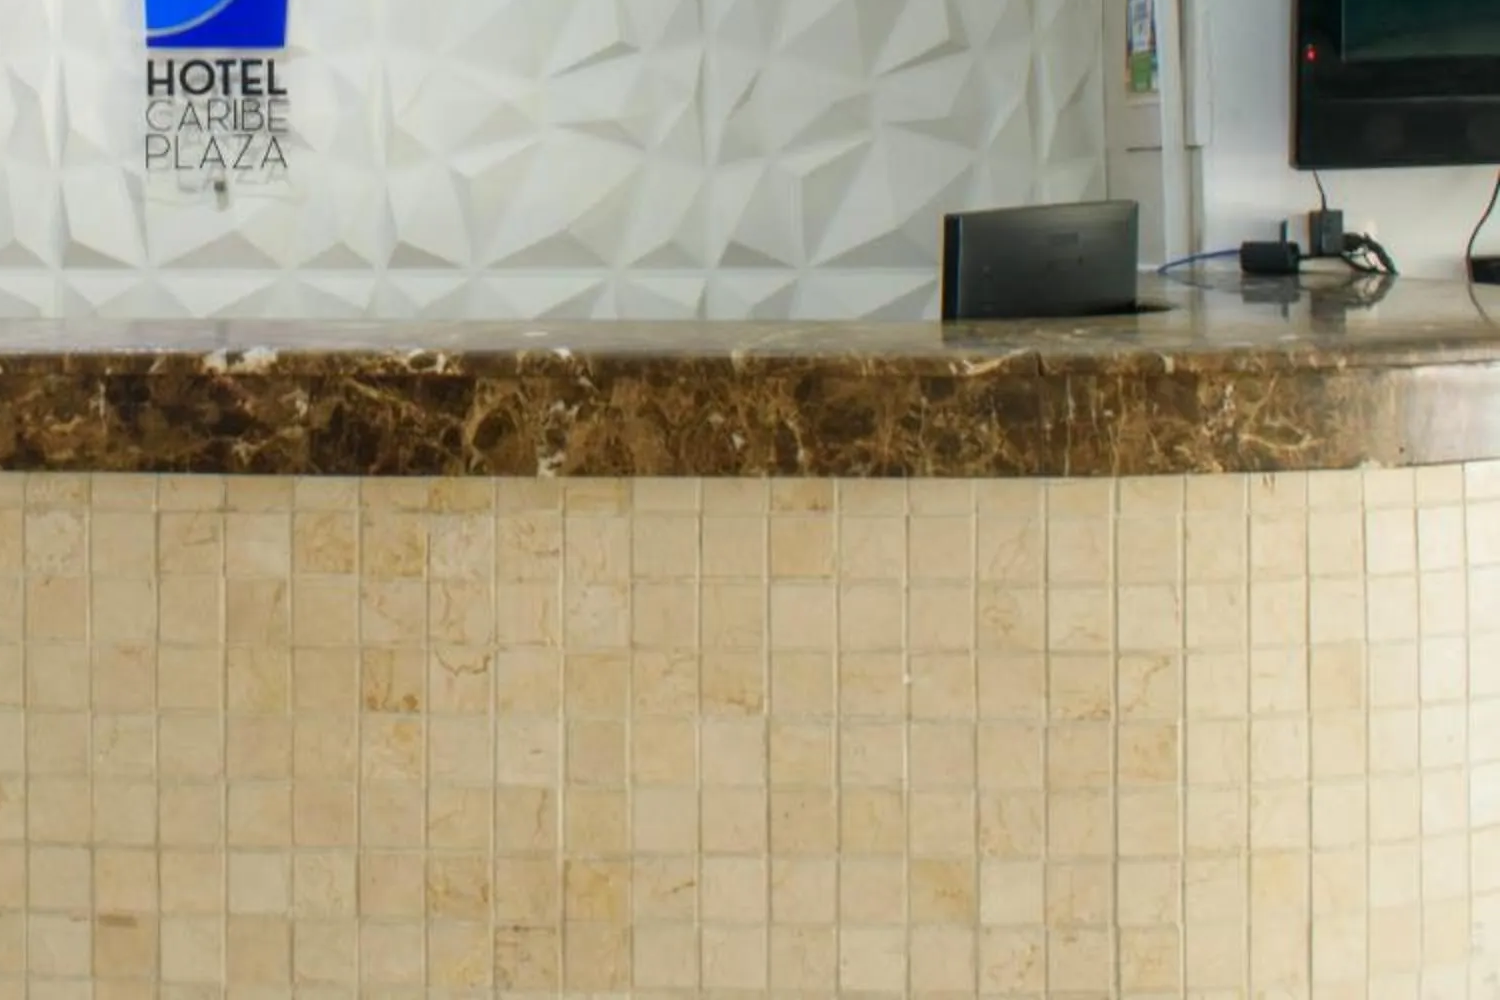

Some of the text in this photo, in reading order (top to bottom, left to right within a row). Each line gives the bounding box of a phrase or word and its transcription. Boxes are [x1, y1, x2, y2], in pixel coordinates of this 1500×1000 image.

[146, 58, 288, 96] HOTEL
[145, 99, 290, 132] CARIBE
[145, 133, 288, 169] PLAZA
